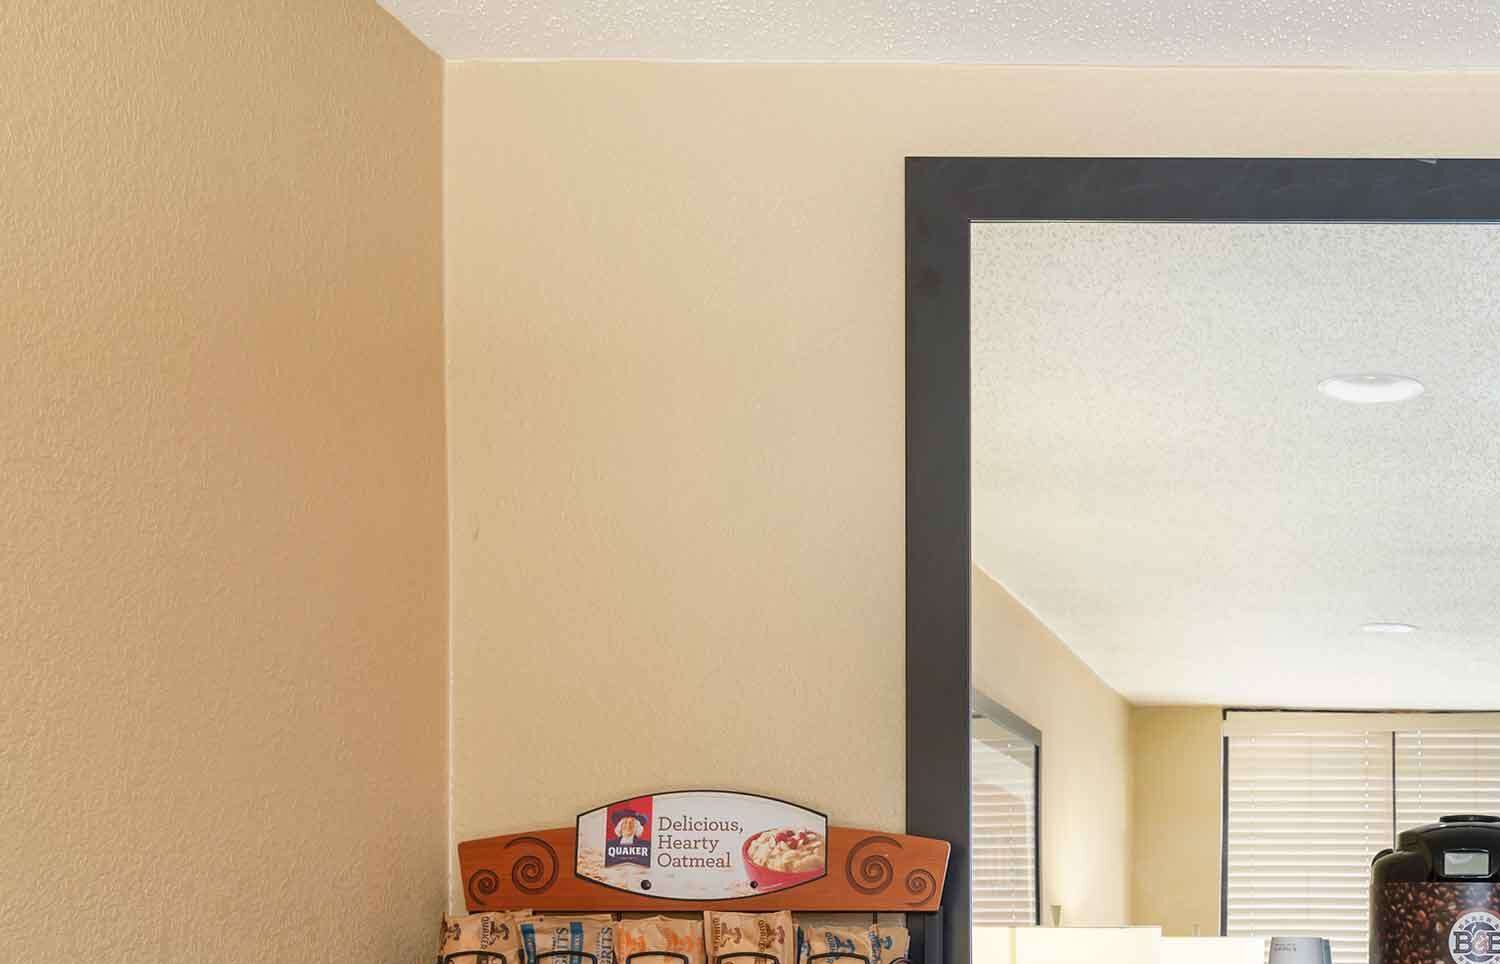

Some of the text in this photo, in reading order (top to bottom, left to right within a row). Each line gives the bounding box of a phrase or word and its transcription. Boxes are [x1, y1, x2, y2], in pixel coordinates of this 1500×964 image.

[657, 815, 744, 834] Delicious,
[608, 846, 648, 857] QUAKER
[656, 835, 720, 853] Hearty
[657, 852, 732, 868] Oatmeal
